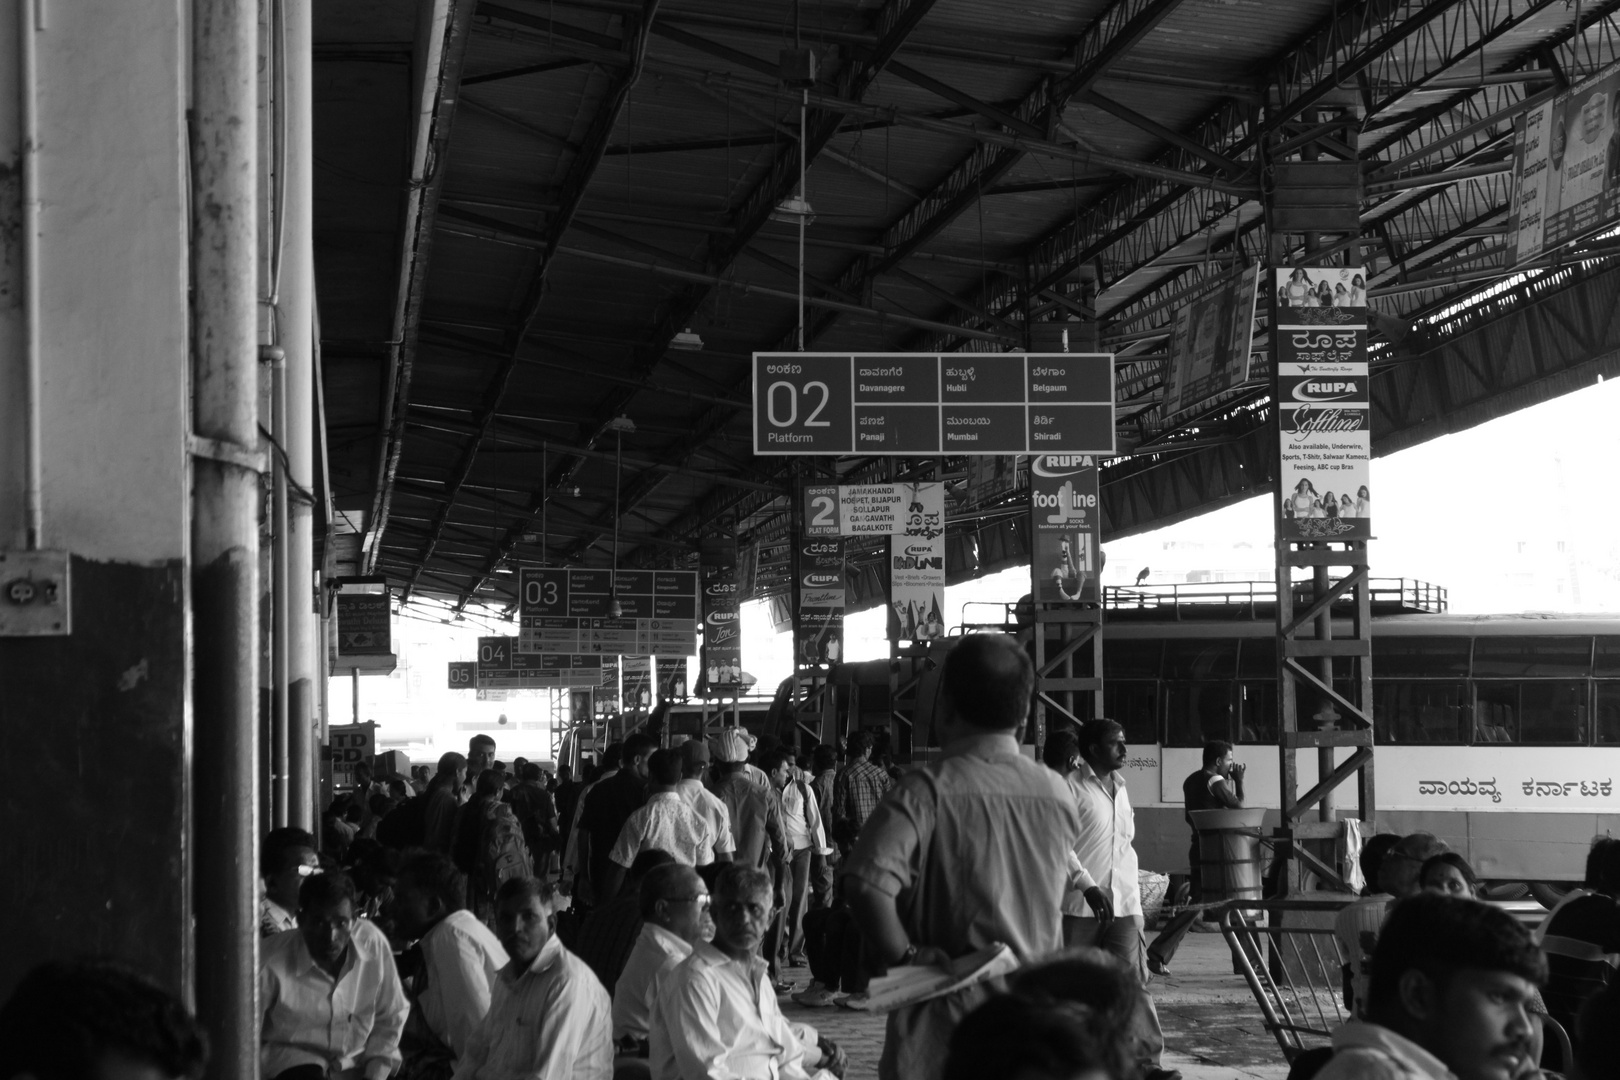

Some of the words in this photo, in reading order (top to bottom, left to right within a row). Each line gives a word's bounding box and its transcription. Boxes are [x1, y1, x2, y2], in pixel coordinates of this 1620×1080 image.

[1292, 330, 1357, 349] ರೂಪ
[767, 363, 802, 375] ಅಂಕಣ
[859, 366, 903, 377] ದಾವಣಗೆರೆ
[946, 366, 976, 381] ಹುಬ್ಬಳ್ಳಿ
[1032, 366, 1066, 377] ಬೆಳಗಾಂ
[859, 384, 905, 393] Davanagere
[946, 384, 967, 392] Hubli
[1033, 384, 1067, 393] Belgaum
[1307, 382, 1357, 393] RUPA
[767, 381, 831, 428] 02
[859, 416, 885, 426] ಪಣಜಿ
[1285, 404, 1364, 442] Softline
[768, 432, 813, 443] Platform
[860, 433, 885, 442] Panaji
[947, 432, 978, 441] Mumbai
[1034, 432, 1062, 441] Shiradi
[1046, 455, 1094, 467] RUPA
[848, 487, 895, 495] JAMAKHANDI
[811, 497, 835, 526] 2
[822, 526, 839, 534] FORM
[852, 524, 893, 532] BAGALKOTE
[526, 581, 558, 605] 03
[803, 592, 842, 603] Frontline
[481, 645, 505, 662] 04
[450, 669, 469, 682] 05
[477, 689, 486, 699] 4
[330, 734, 367, 747] TD
[1418, 776, 1503, 803] ವಾಯವ್ಯ
[1521, 776, 1613, 798] ಕರ್ನಾಟಕ
